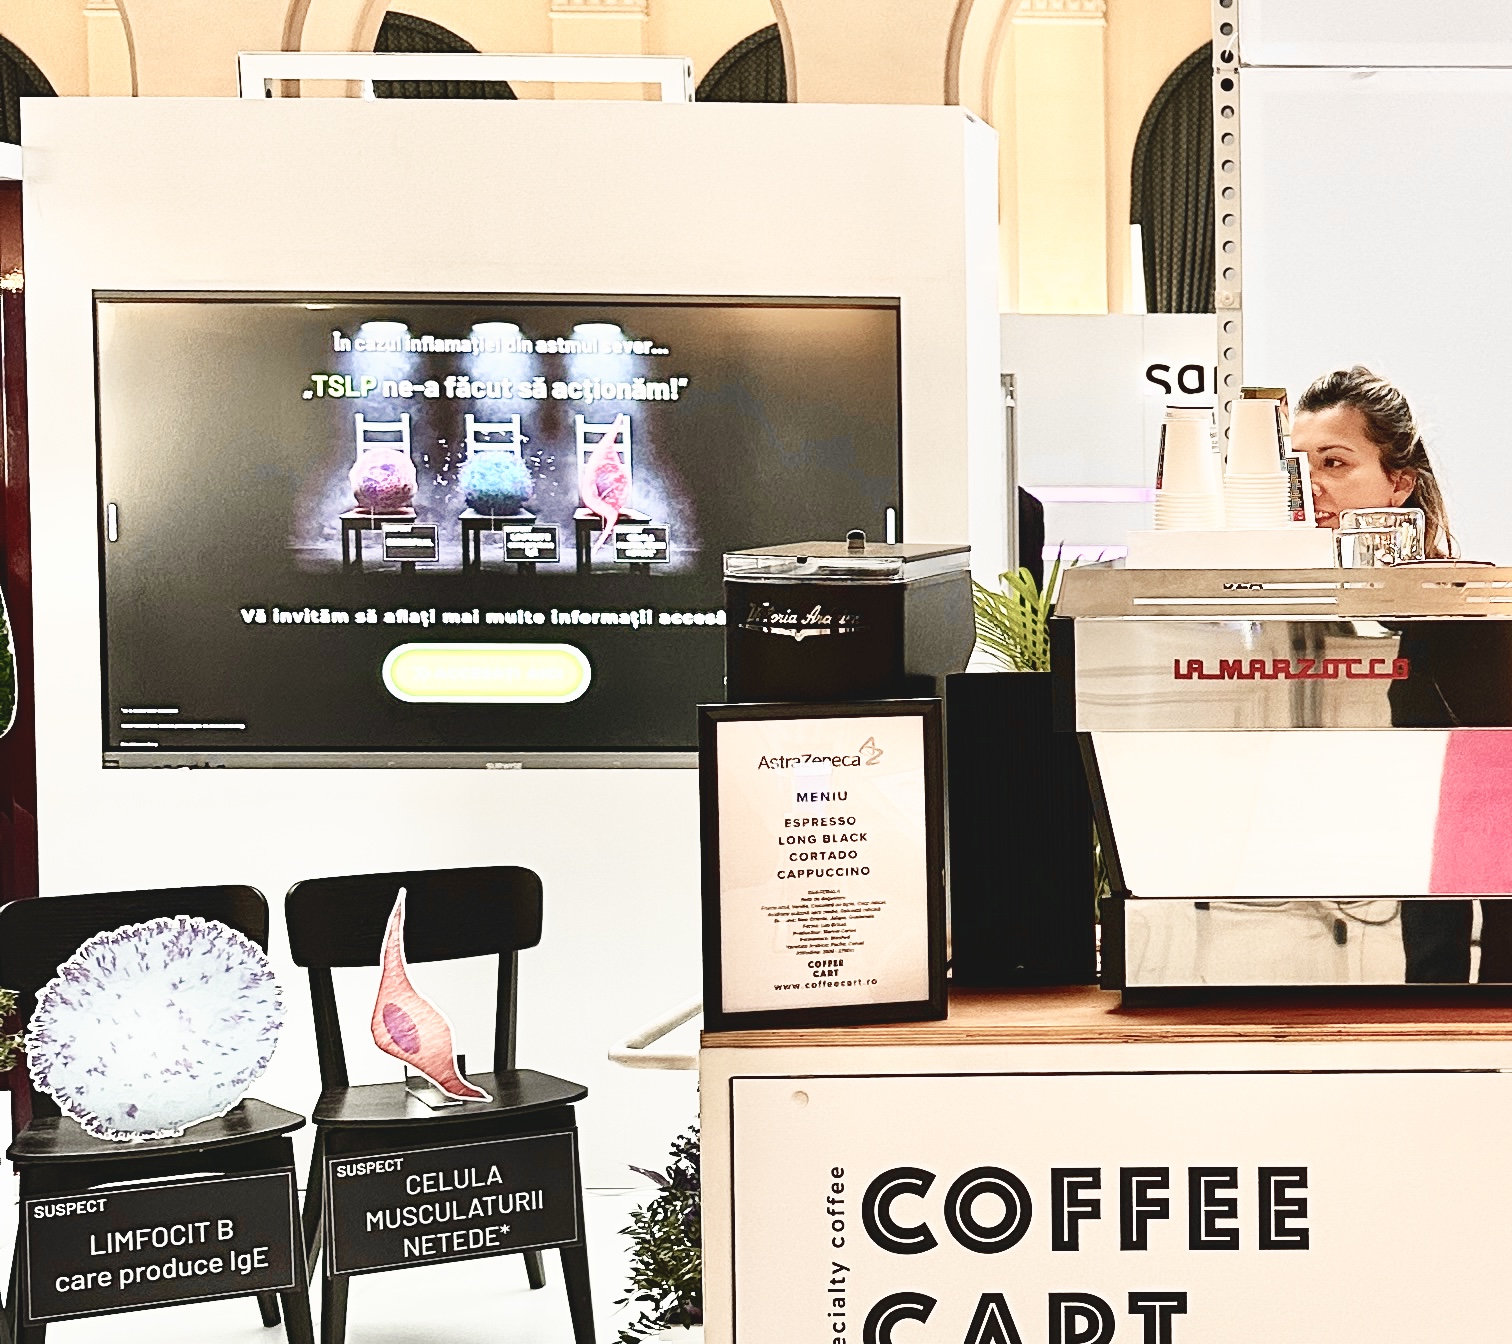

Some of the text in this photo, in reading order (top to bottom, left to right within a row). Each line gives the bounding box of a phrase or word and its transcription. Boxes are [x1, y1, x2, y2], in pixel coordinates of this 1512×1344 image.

[355, 335, 402, 353] cazul
[506, 335, 533, 353] din
[536, 336, 600, 353] astmul
[382, 379, 440, 399] ne-a
[444, 376, 513, 399] făcut
[516, 376, 548, 399] să
[1146, 364, 1217, 395] sa
[240, 608, 267, 624] Vă
[272, 607, 350, 624] invităm
[354, 608, 378, 624] să
[382, 608, 436, 628] aflați
[441, 608, 480, 624] mai
[485, 608, 546, 625] multe
[757, 754, 861, 770] AstraZeneca
[796, 790, 848, 803] MENIU
[784, 816, 857, 828] ESPRESSO
[778, 832, 868, 846] LONG BLACK
[789, 849, 858, 862] CORTADO
[776, 866, 871, 880] CAPPUCCINO
[812, 969, 839, 978] CART
[335, 1157, 404, 1178] SUSPECT
[405, 1164, 503, 1196] CELULA
[33, 1197, 107, 1219] SUSPECT
[366, 1188, 544, 1232] MUSCULATURII
[826, 1166, 846, 1249] coffee
[861, 1166, 1310, 1255] COFFEE
[89, 1219, 234, 1256] LIMFOCIT B
[55, 1246, 269, 1293] care produce IgE
